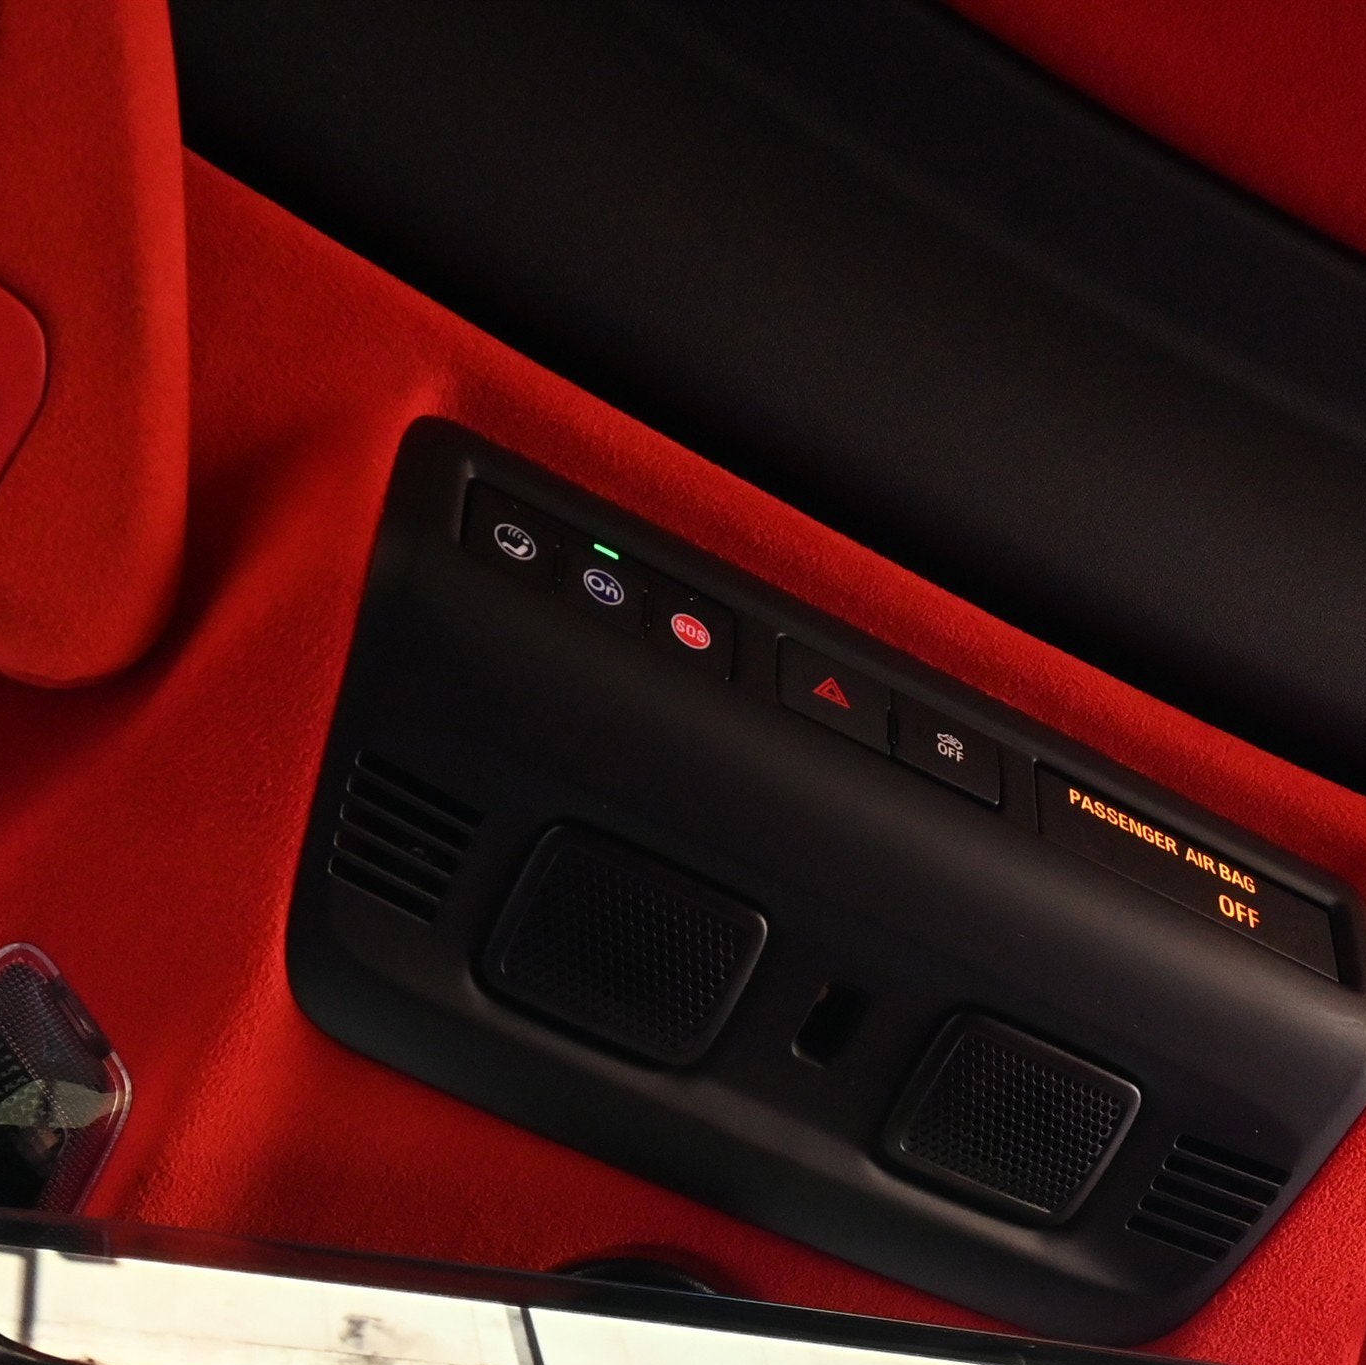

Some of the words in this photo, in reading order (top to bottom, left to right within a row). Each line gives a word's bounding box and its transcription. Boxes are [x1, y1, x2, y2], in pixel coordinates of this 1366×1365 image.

[586, 574, 619, 601] On
[675, 619, 707, 643] SOS
[937, 741, 964, 762] OFF
[1068, 787, 1179, 856] PASSENGER
[1185, 847, 1217, 875] AIR
[1218, 862, 1256, 894] BAG
[1218, 894, 1261, 929] OFF
